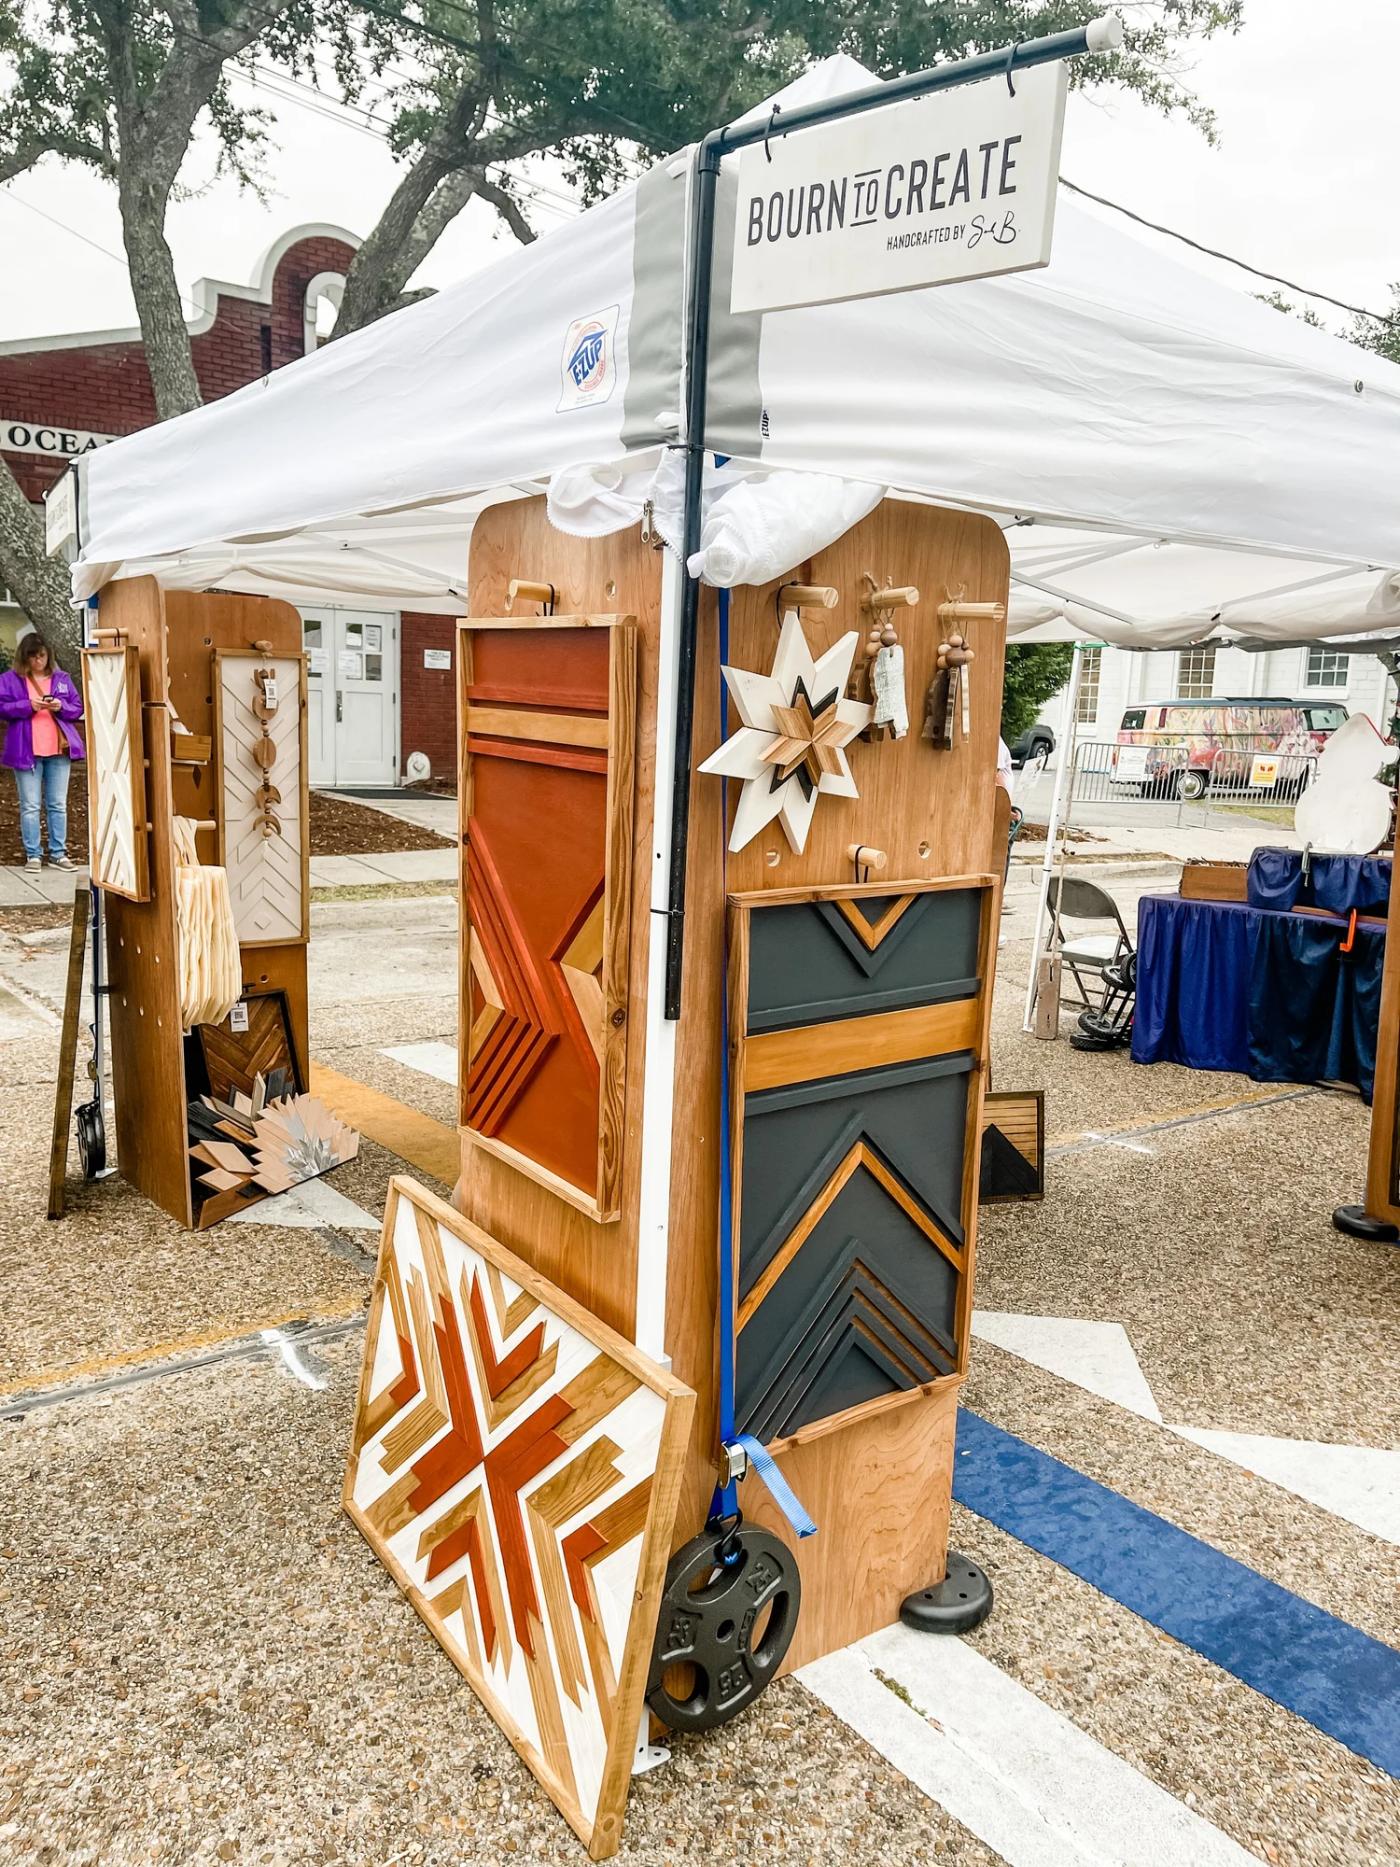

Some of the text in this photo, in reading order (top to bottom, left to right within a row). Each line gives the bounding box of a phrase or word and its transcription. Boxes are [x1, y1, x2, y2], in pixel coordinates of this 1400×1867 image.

[748, 134, 1022, 246] BOURN TO CREATE
[887, 224, 965, 251] HANDCRAFTED BY
